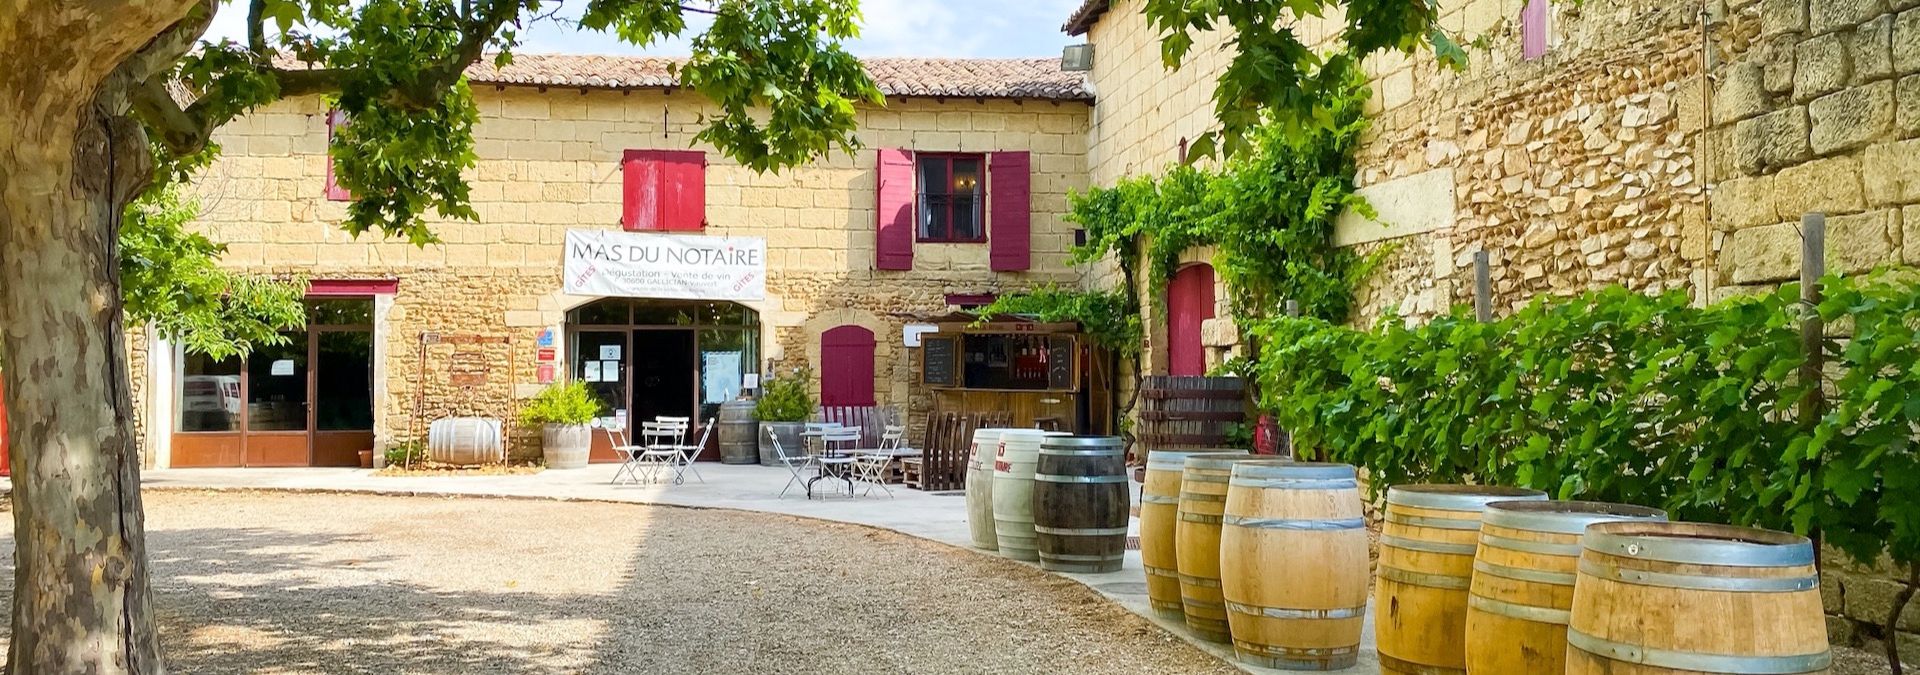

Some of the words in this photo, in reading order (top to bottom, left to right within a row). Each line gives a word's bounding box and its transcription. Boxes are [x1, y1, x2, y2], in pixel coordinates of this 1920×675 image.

[572, 242, 622, 262] MAS
[628, 245, 660, 263] DU
[701, 272, 714, 280] de
[716, 272, 731, 280] vin
